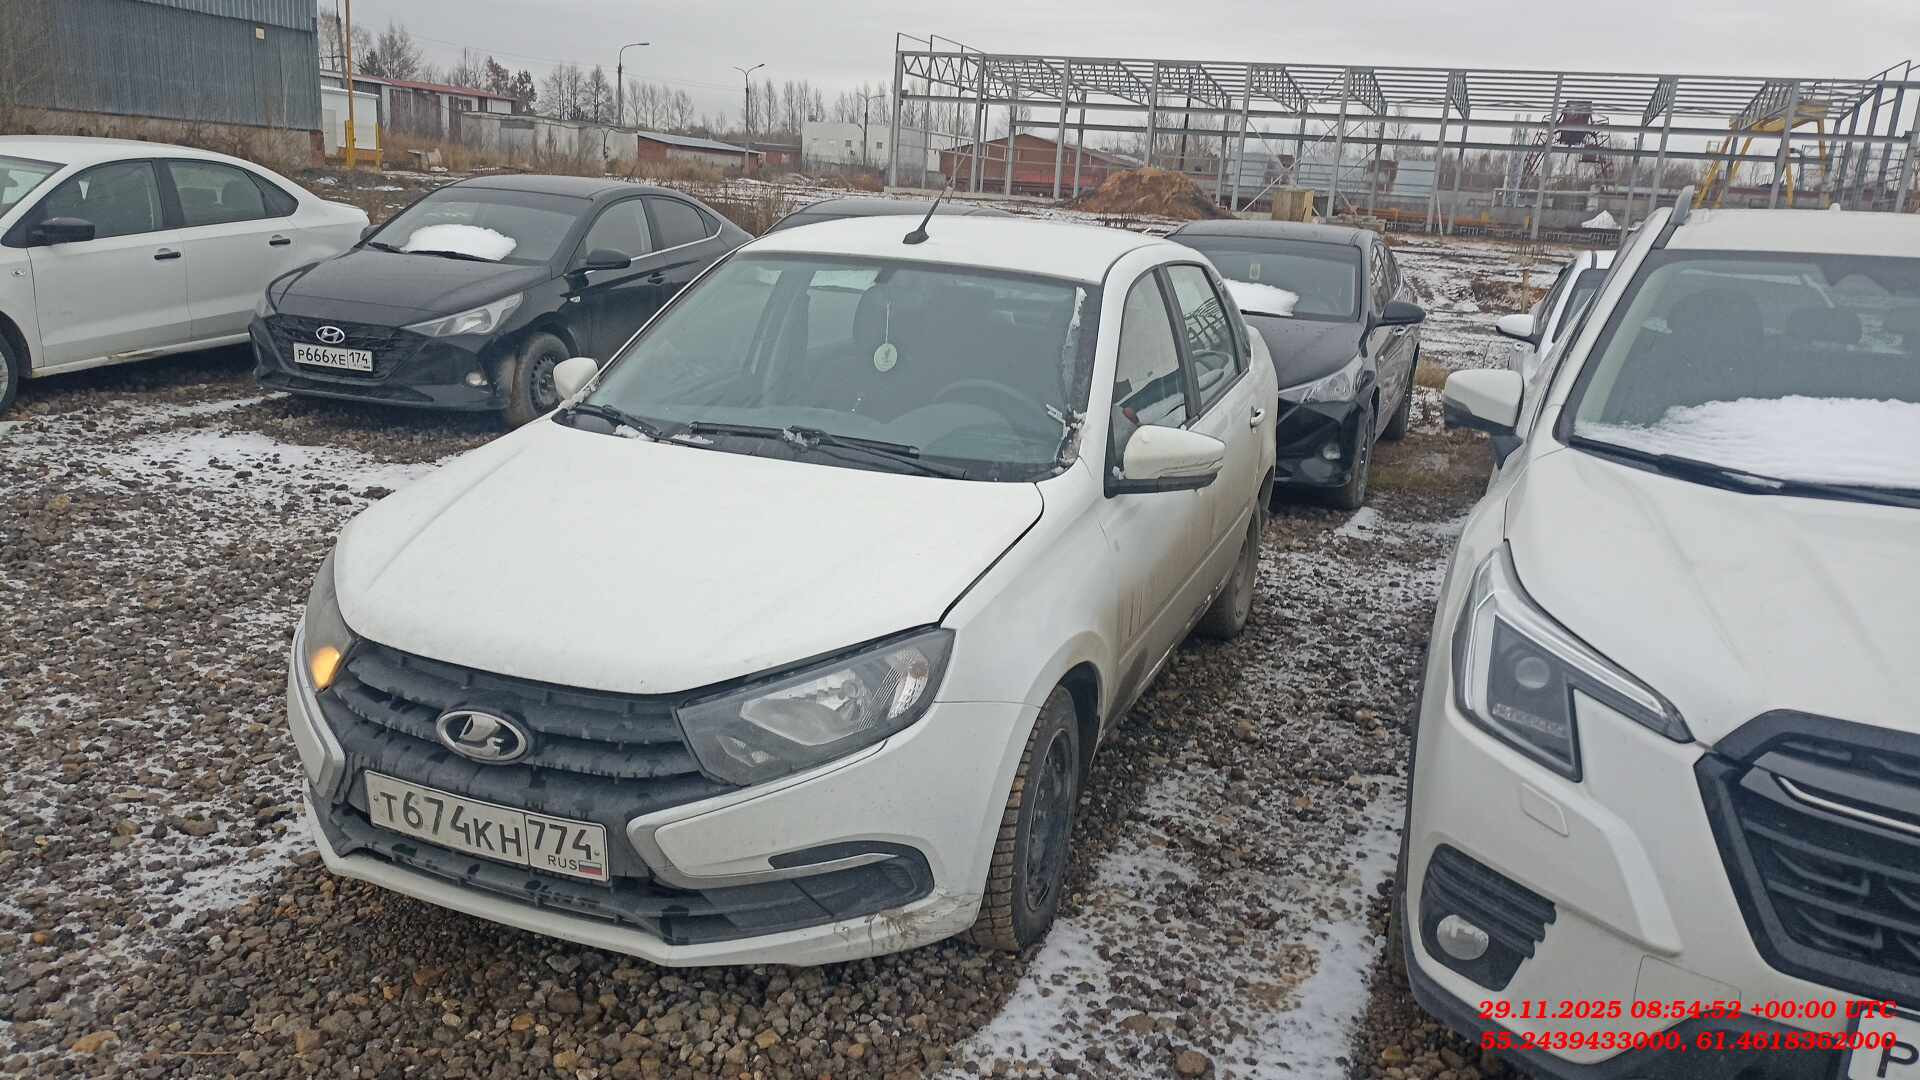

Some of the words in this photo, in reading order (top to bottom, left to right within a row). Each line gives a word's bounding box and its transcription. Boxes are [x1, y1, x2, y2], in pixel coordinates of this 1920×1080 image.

[298, 347, 345, 365] Р666ХЕ
[349, 351, 368, 364] 174
[380, 791, 522, 857] Т674КН
[528, 819, 592, 861] 774
[548, 854, 578, 871] RUS
